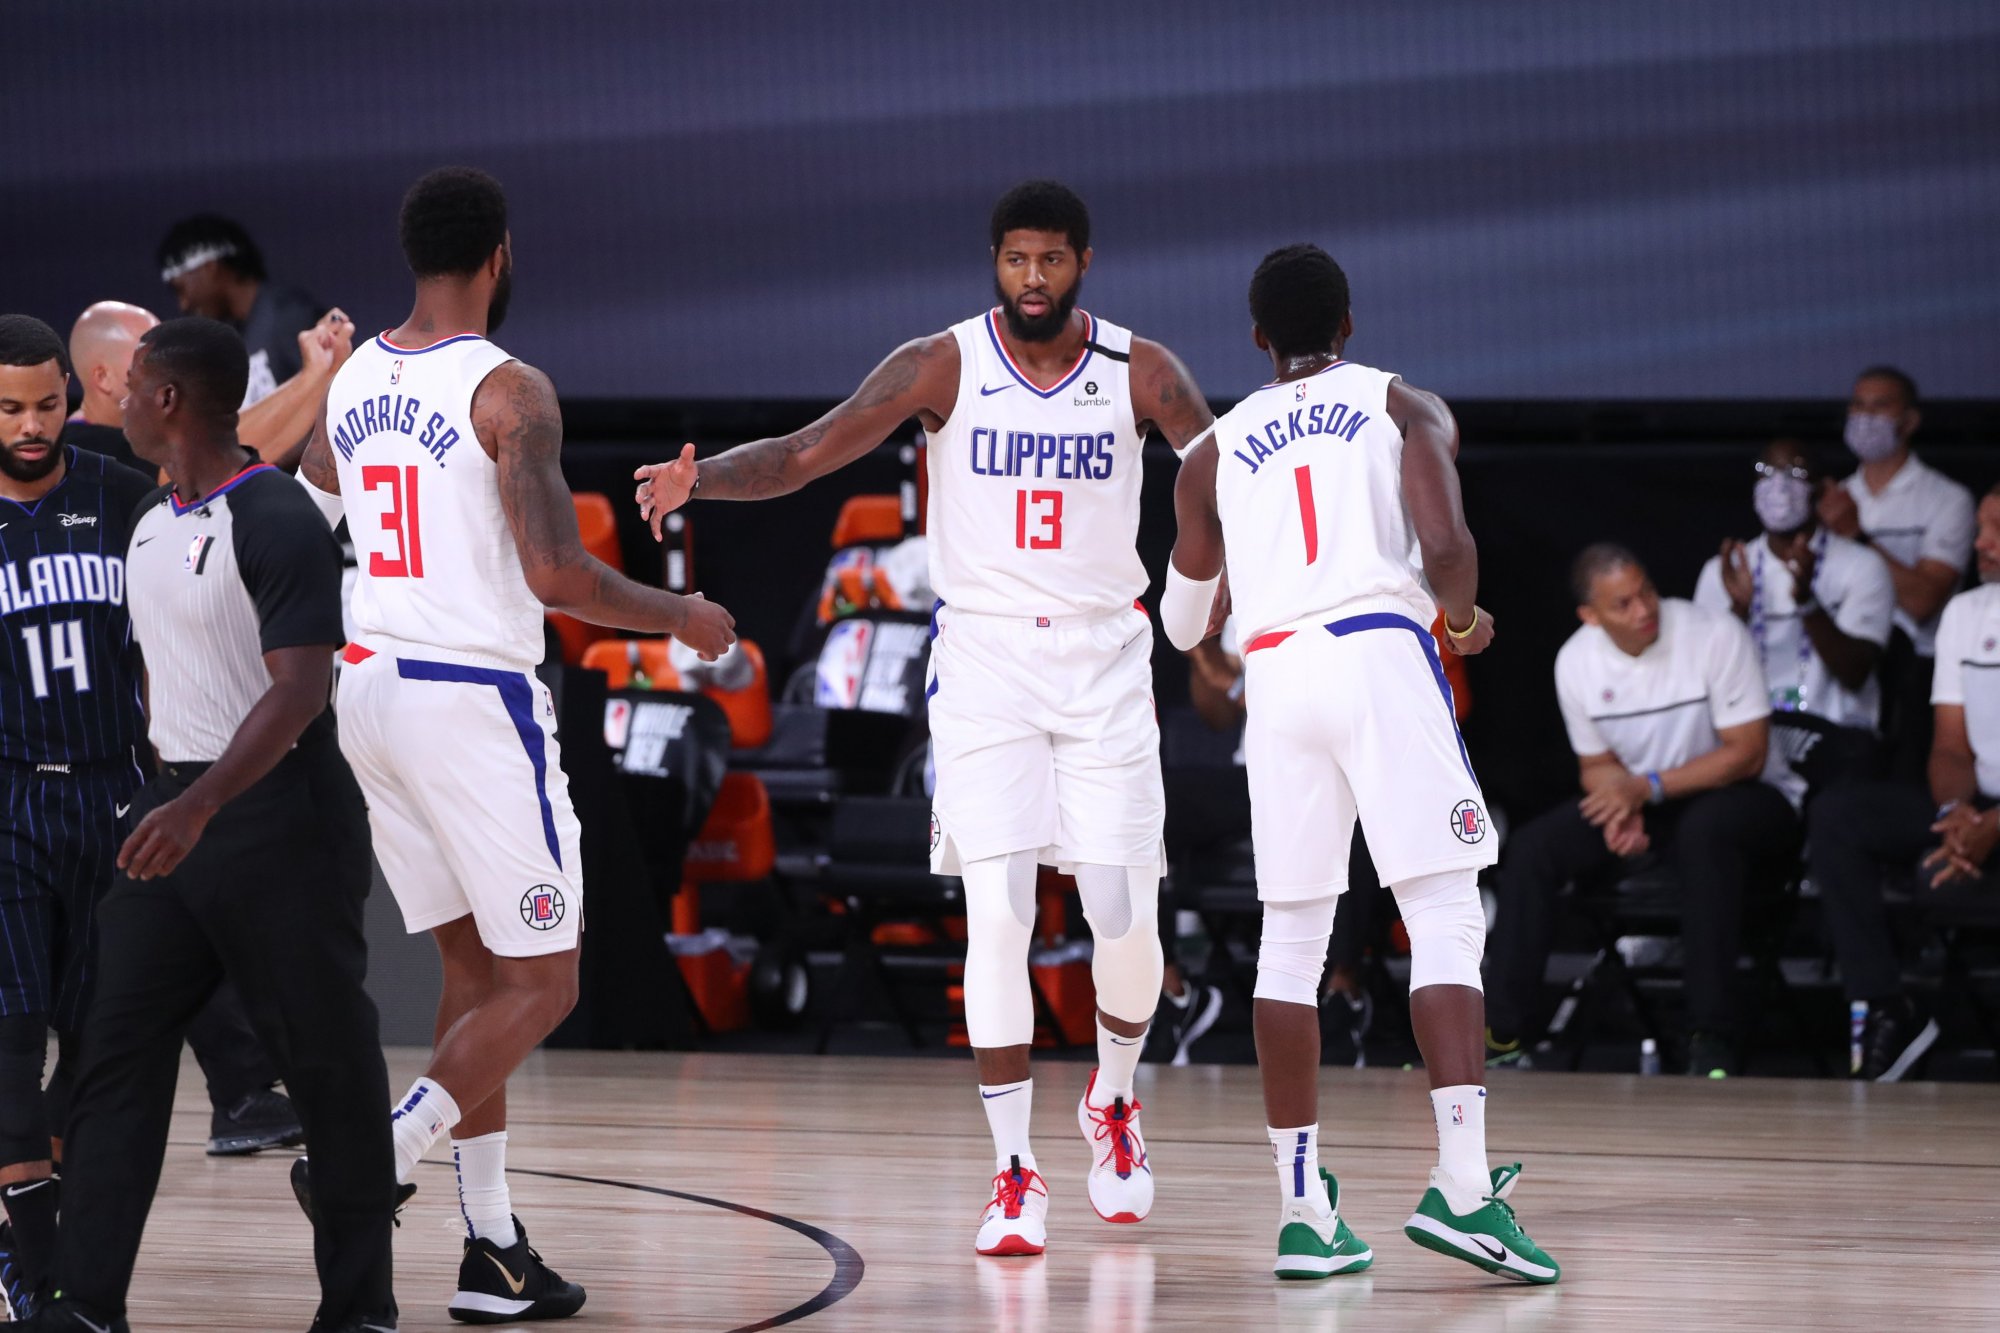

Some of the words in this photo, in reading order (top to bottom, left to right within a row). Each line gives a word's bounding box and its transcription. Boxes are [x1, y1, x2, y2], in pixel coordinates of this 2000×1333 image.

[334, 394, 420, 463] MORRIS
[418, 411, 460, 469] SR.
[1073, 397, 1111, 407] bumble
[970, 426, 1115, 480] CLIPPERS
[1233, 403, 1370, 475] JACKSON
[361, 465, 424, 578] 31
[1016, 489, 1063, 550] 13
[1294, 464, 1318, 566] 1
[21, 619, 91, 698] 14
